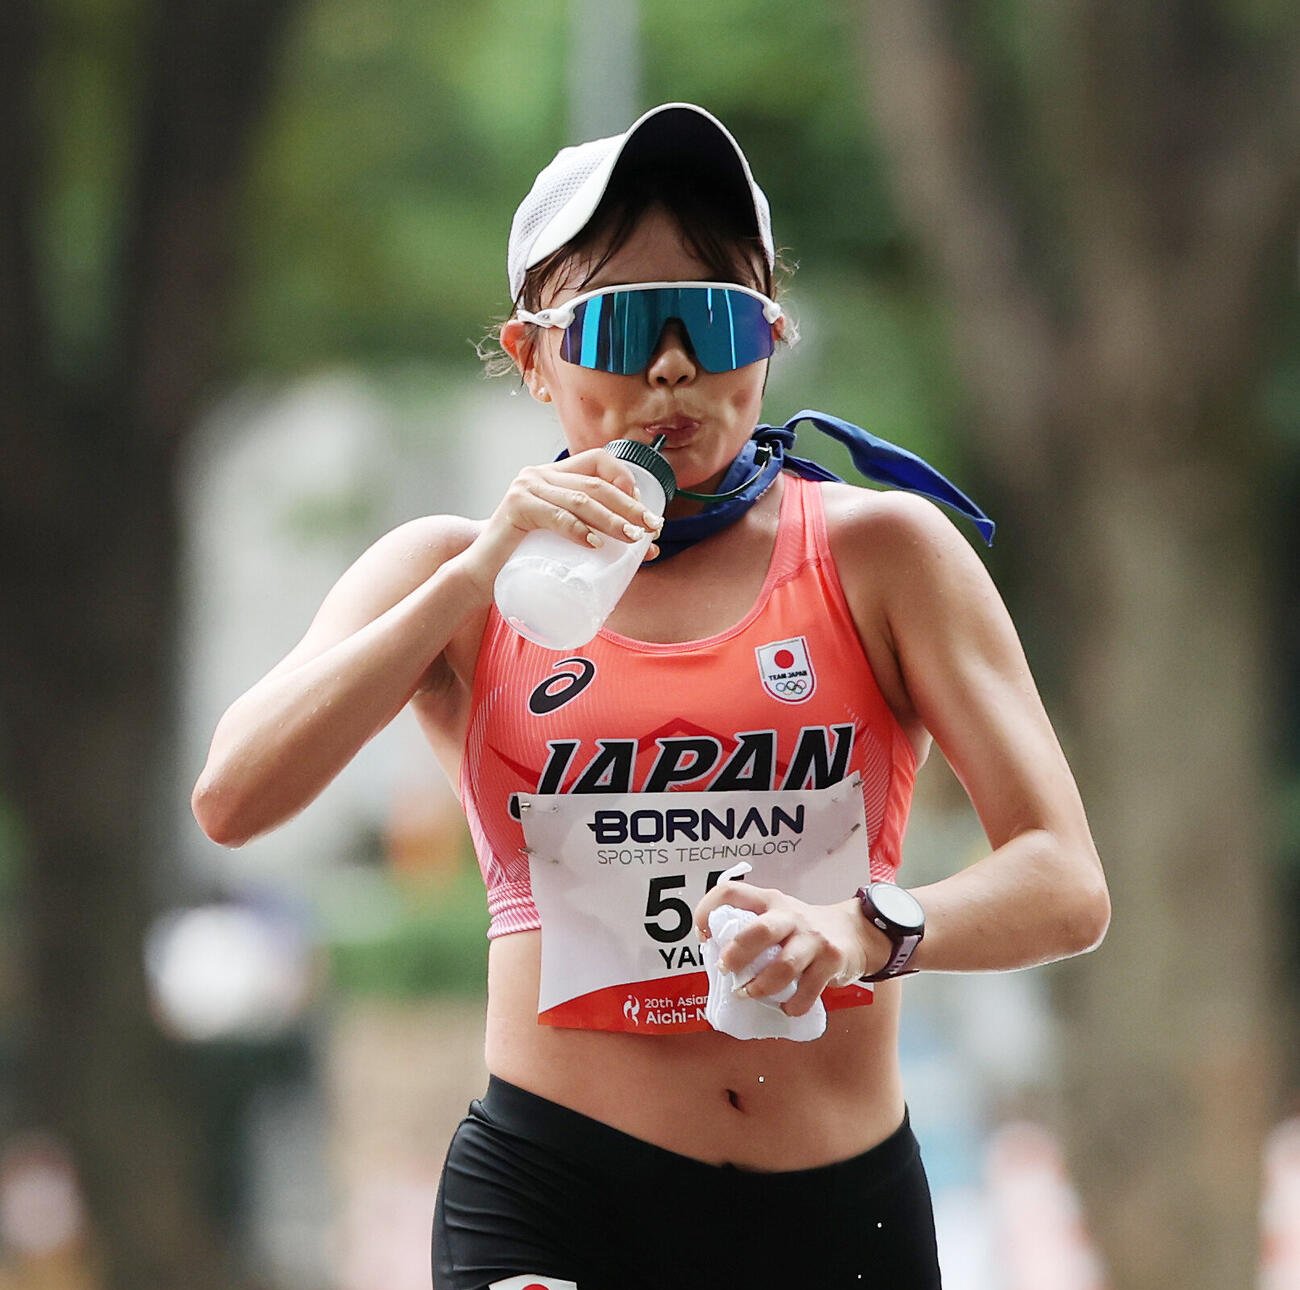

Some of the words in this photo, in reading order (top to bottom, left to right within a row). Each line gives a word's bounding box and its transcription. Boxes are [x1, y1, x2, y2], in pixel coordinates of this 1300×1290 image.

[508, 722, 855, 822] JAPAN
[587, 804, 805, 844] BORNAN
[597, 848, 669, 865] SPORTS
[676, 838, 802, 864] TECHNOLOGY
[658, 944, 704, 970] YA
[644, 998, 673, 1009] 20th
